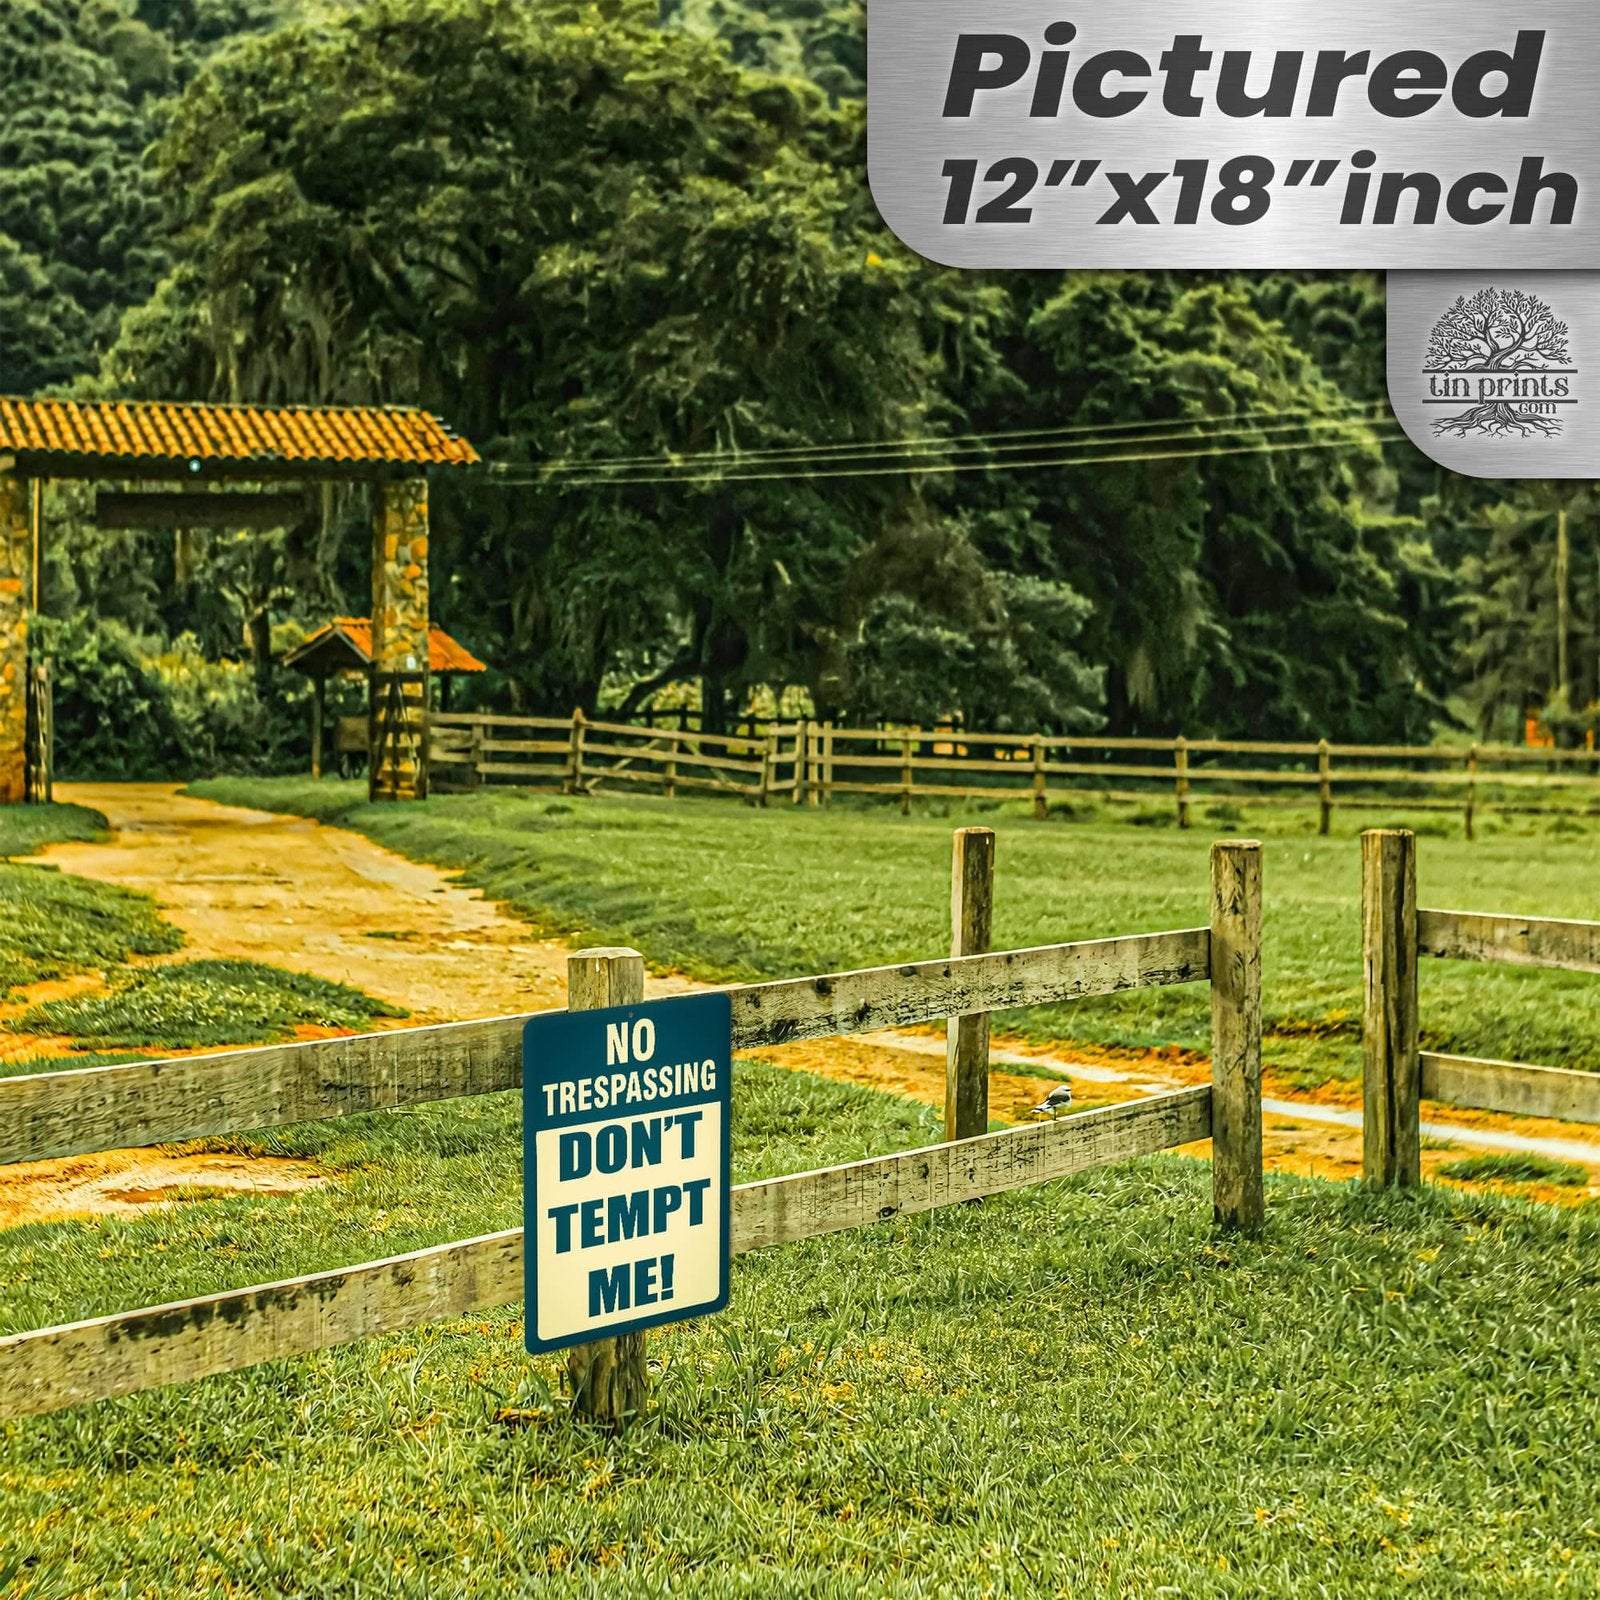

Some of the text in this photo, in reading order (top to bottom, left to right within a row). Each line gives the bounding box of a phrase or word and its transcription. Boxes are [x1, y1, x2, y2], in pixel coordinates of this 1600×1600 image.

[606, 1017, 656, 1066] NO
[542, 1059, 717, 1116] TRESPASSING
[559, 1111, 703, 1182] DON'T
[548, 1178, 711, 1254] TEMPT
[588, 1253, 675, 1318] ME!
